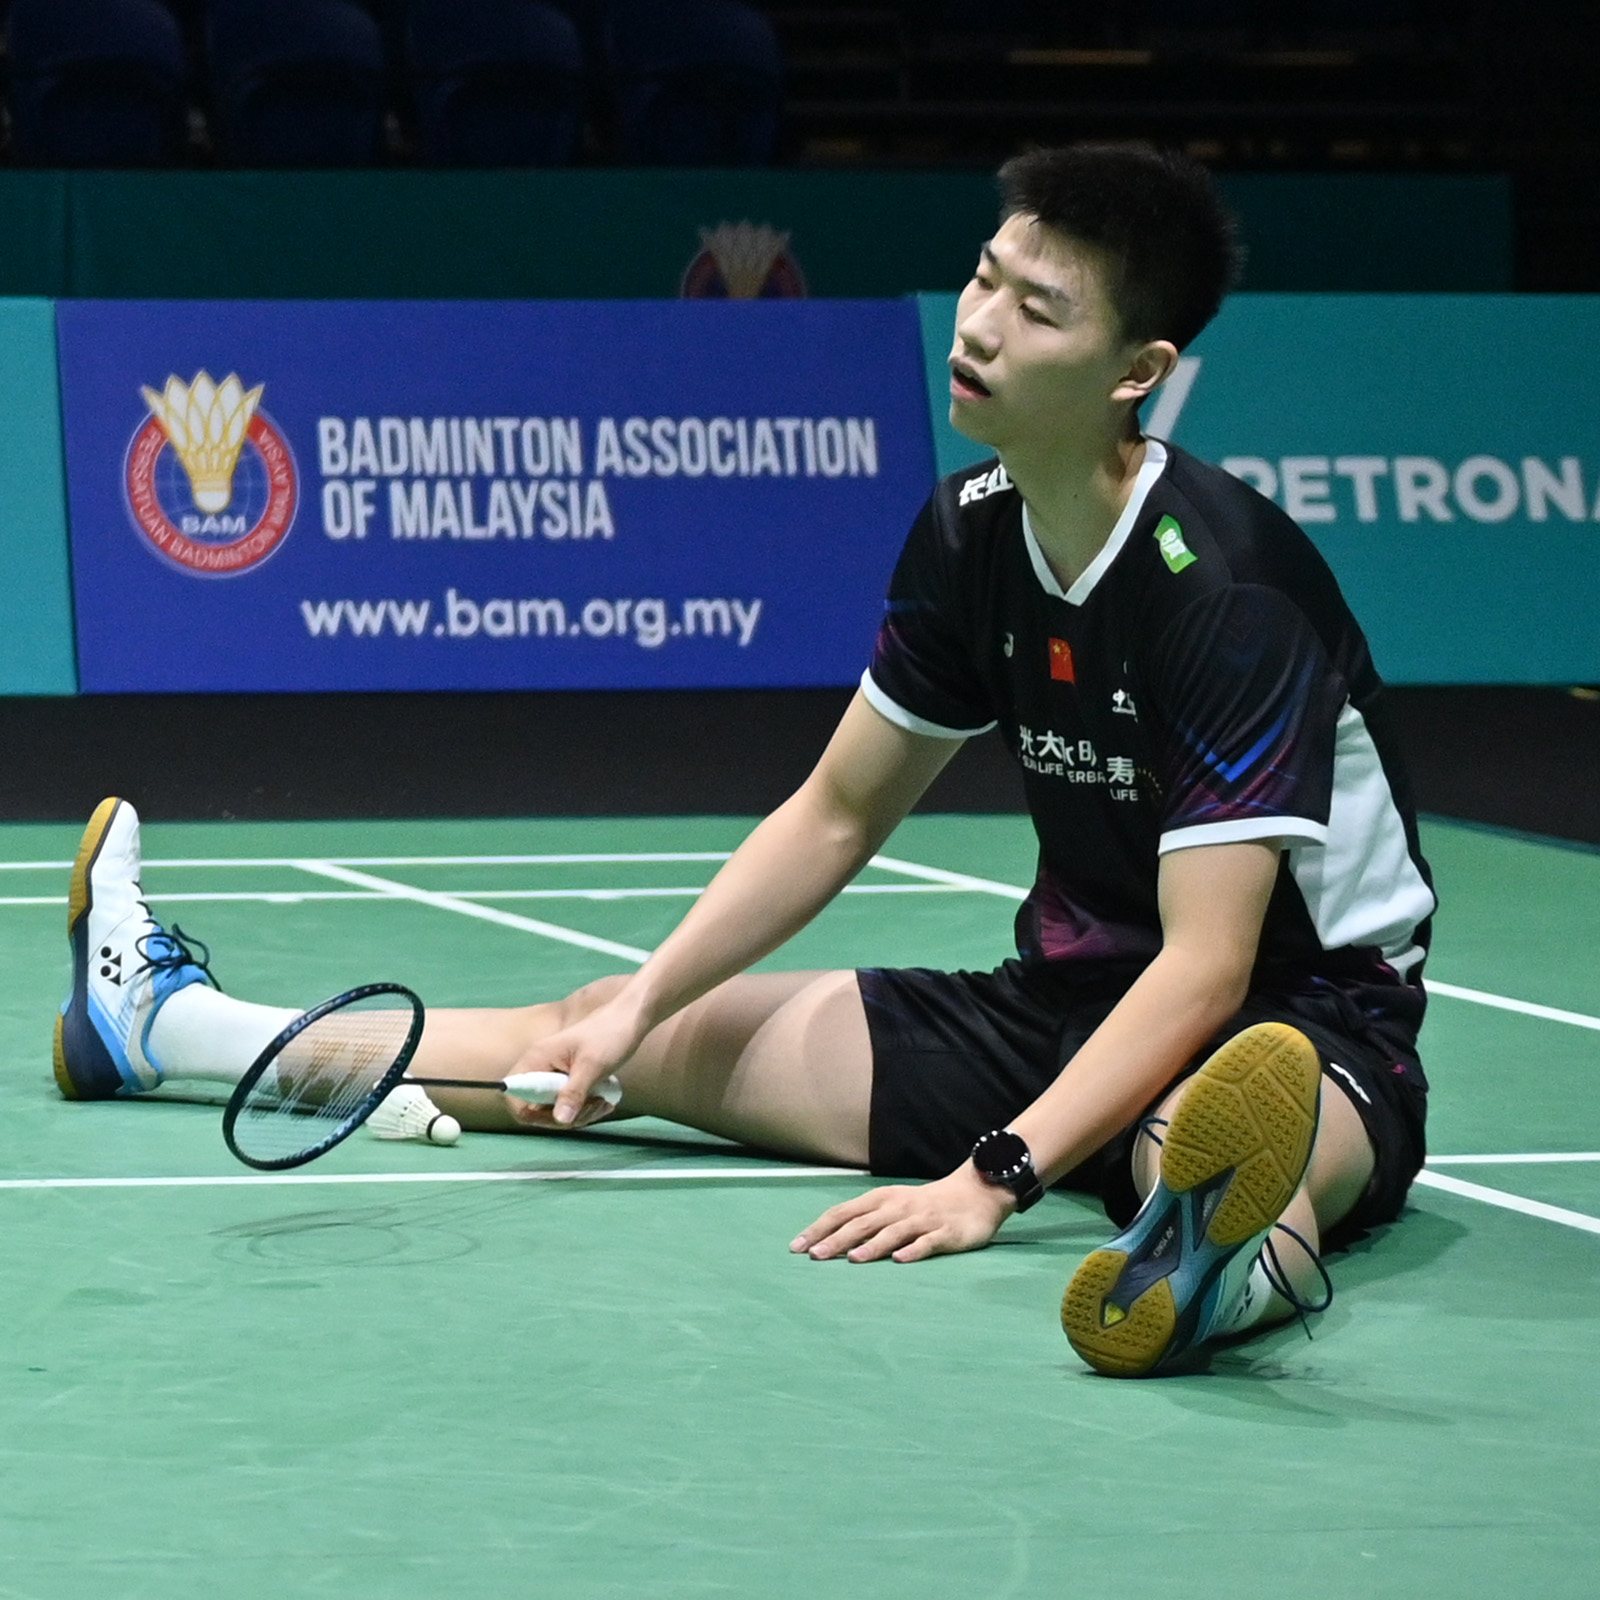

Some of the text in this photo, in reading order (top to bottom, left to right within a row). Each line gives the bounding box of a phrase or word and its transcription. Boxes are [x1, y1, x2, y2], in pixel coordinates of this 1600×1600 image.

[318, 416, 879, 479] BADMINTON ASSOCIATION
[320, 480, 615, 540] OF MALAYSIA
[1221, 455, 1600, 524] PETRON
[181, 515, 247, 536] BAM
[301, 590, 764, 648] www.bam.org.my
[1038, 761, 1064, 776] LIFE
[1110, 788, 1139, 802] LIFE
